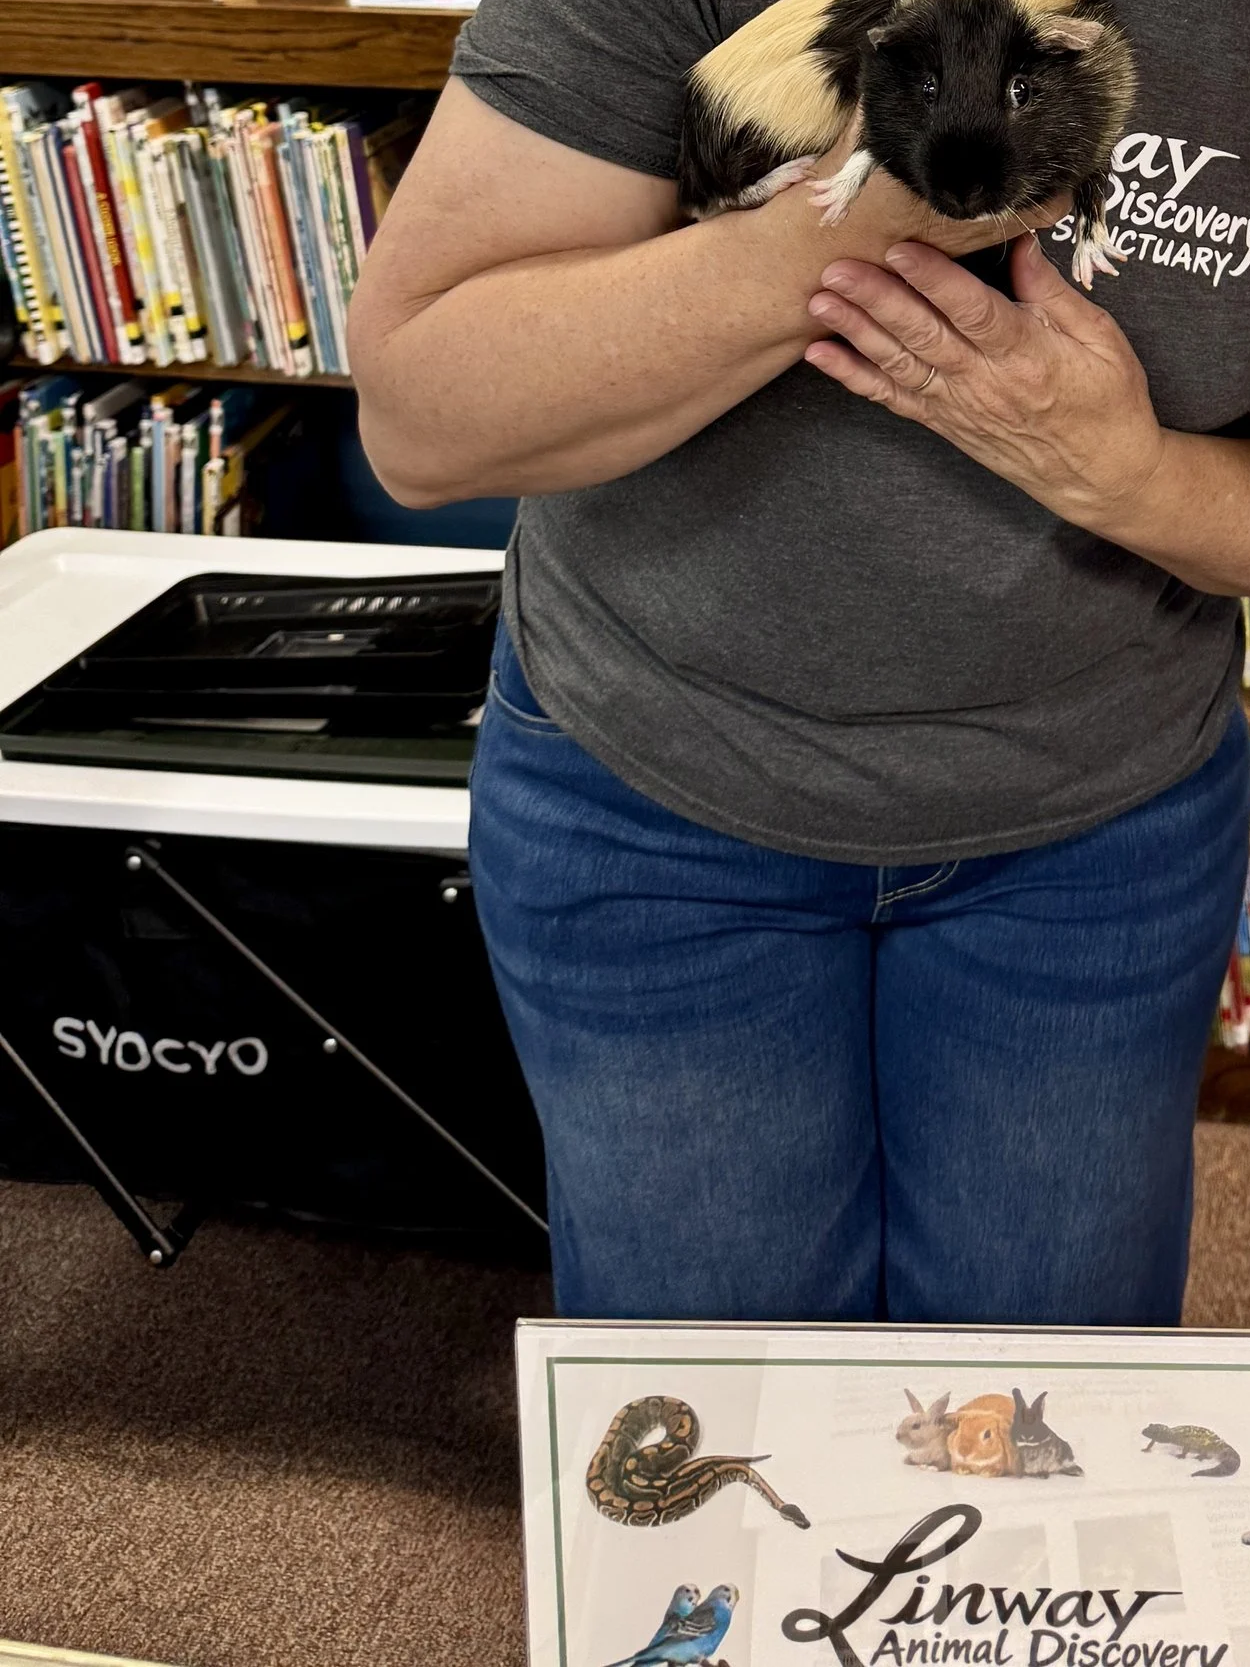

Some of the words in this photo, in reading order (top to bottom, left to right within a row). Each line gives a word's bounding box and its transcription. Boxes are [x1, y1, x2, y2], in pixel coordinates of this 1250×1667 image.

[53, 1016, 269, 1076] SYOCYO
[781, 1503, 1184, 1667] Linway
[869, 1629, 1012, 1667] Animal
[1028, 1628, 1229, 1667] Discovery
